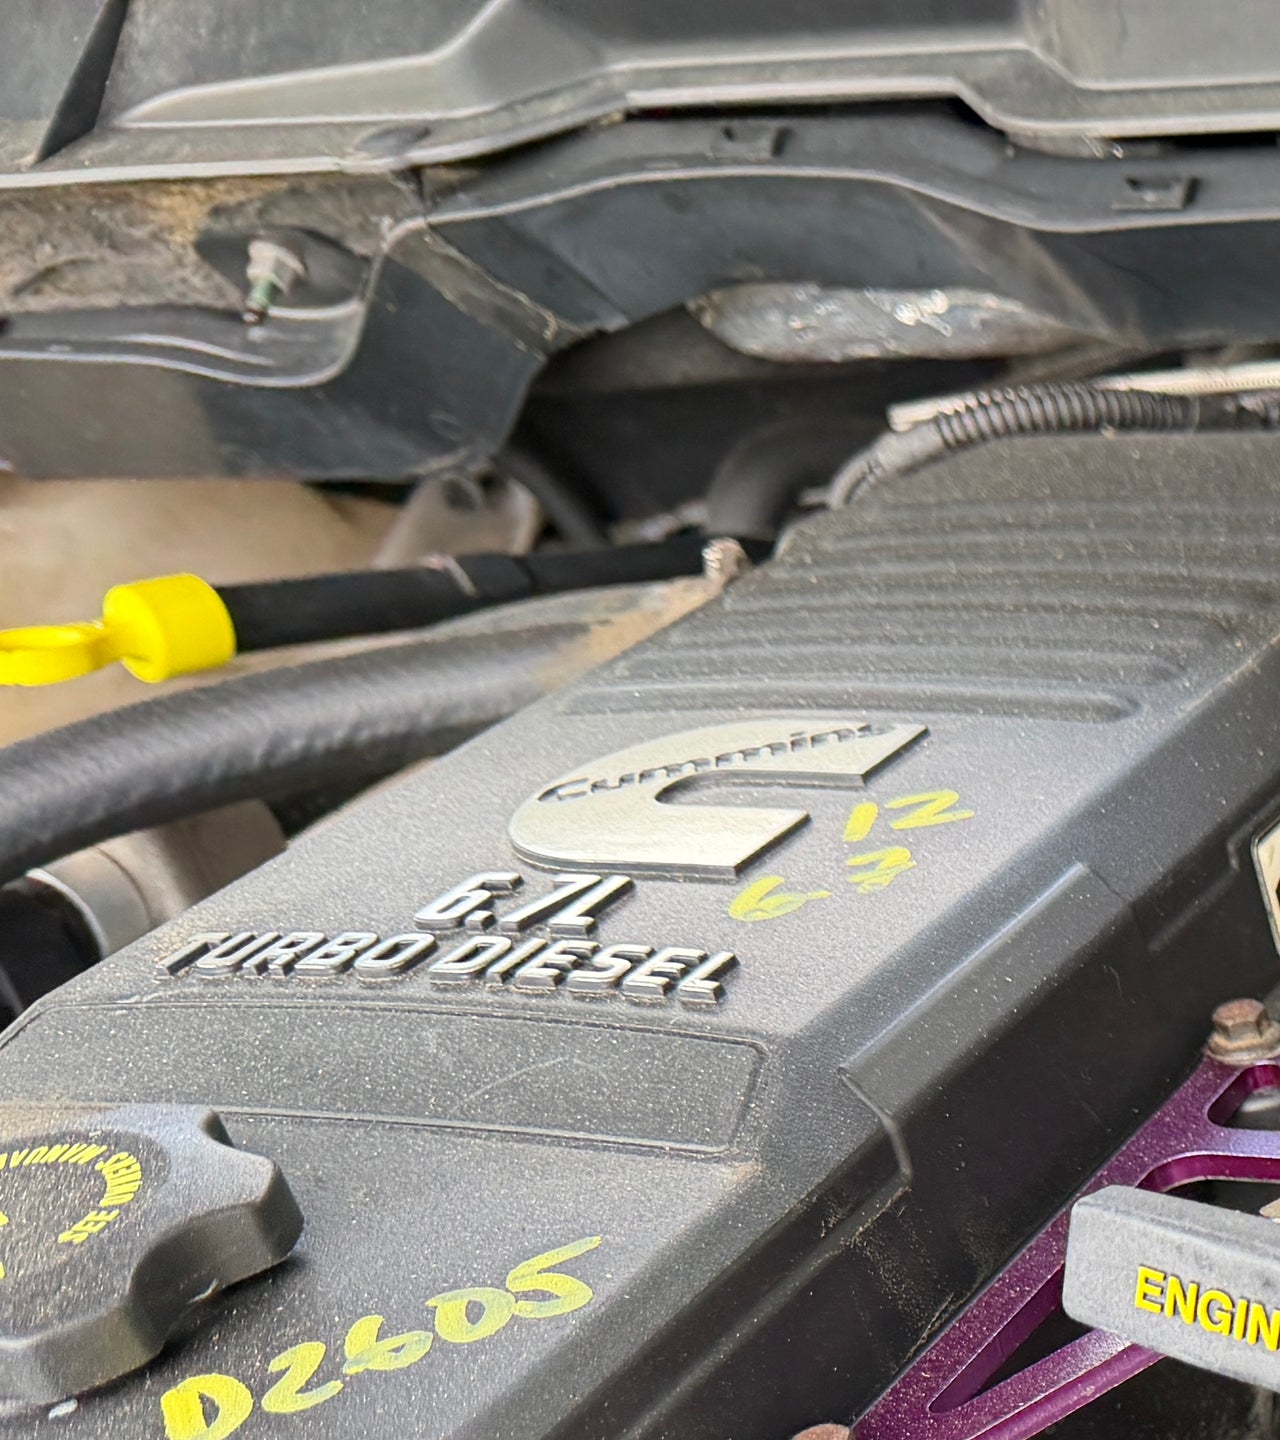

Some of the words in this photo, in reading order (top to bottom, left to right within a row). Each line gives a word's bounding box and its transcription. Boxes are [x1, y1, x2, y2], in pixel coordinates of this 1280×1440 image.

[538, 722, 897, 802] Cummins
[413, 872, 634, 939] 6.7L
[155, 931, 437, 985] TURBO
[428, 935, 741, 1004] DIESEL
[58, 1209, 120, 1245] SEE
